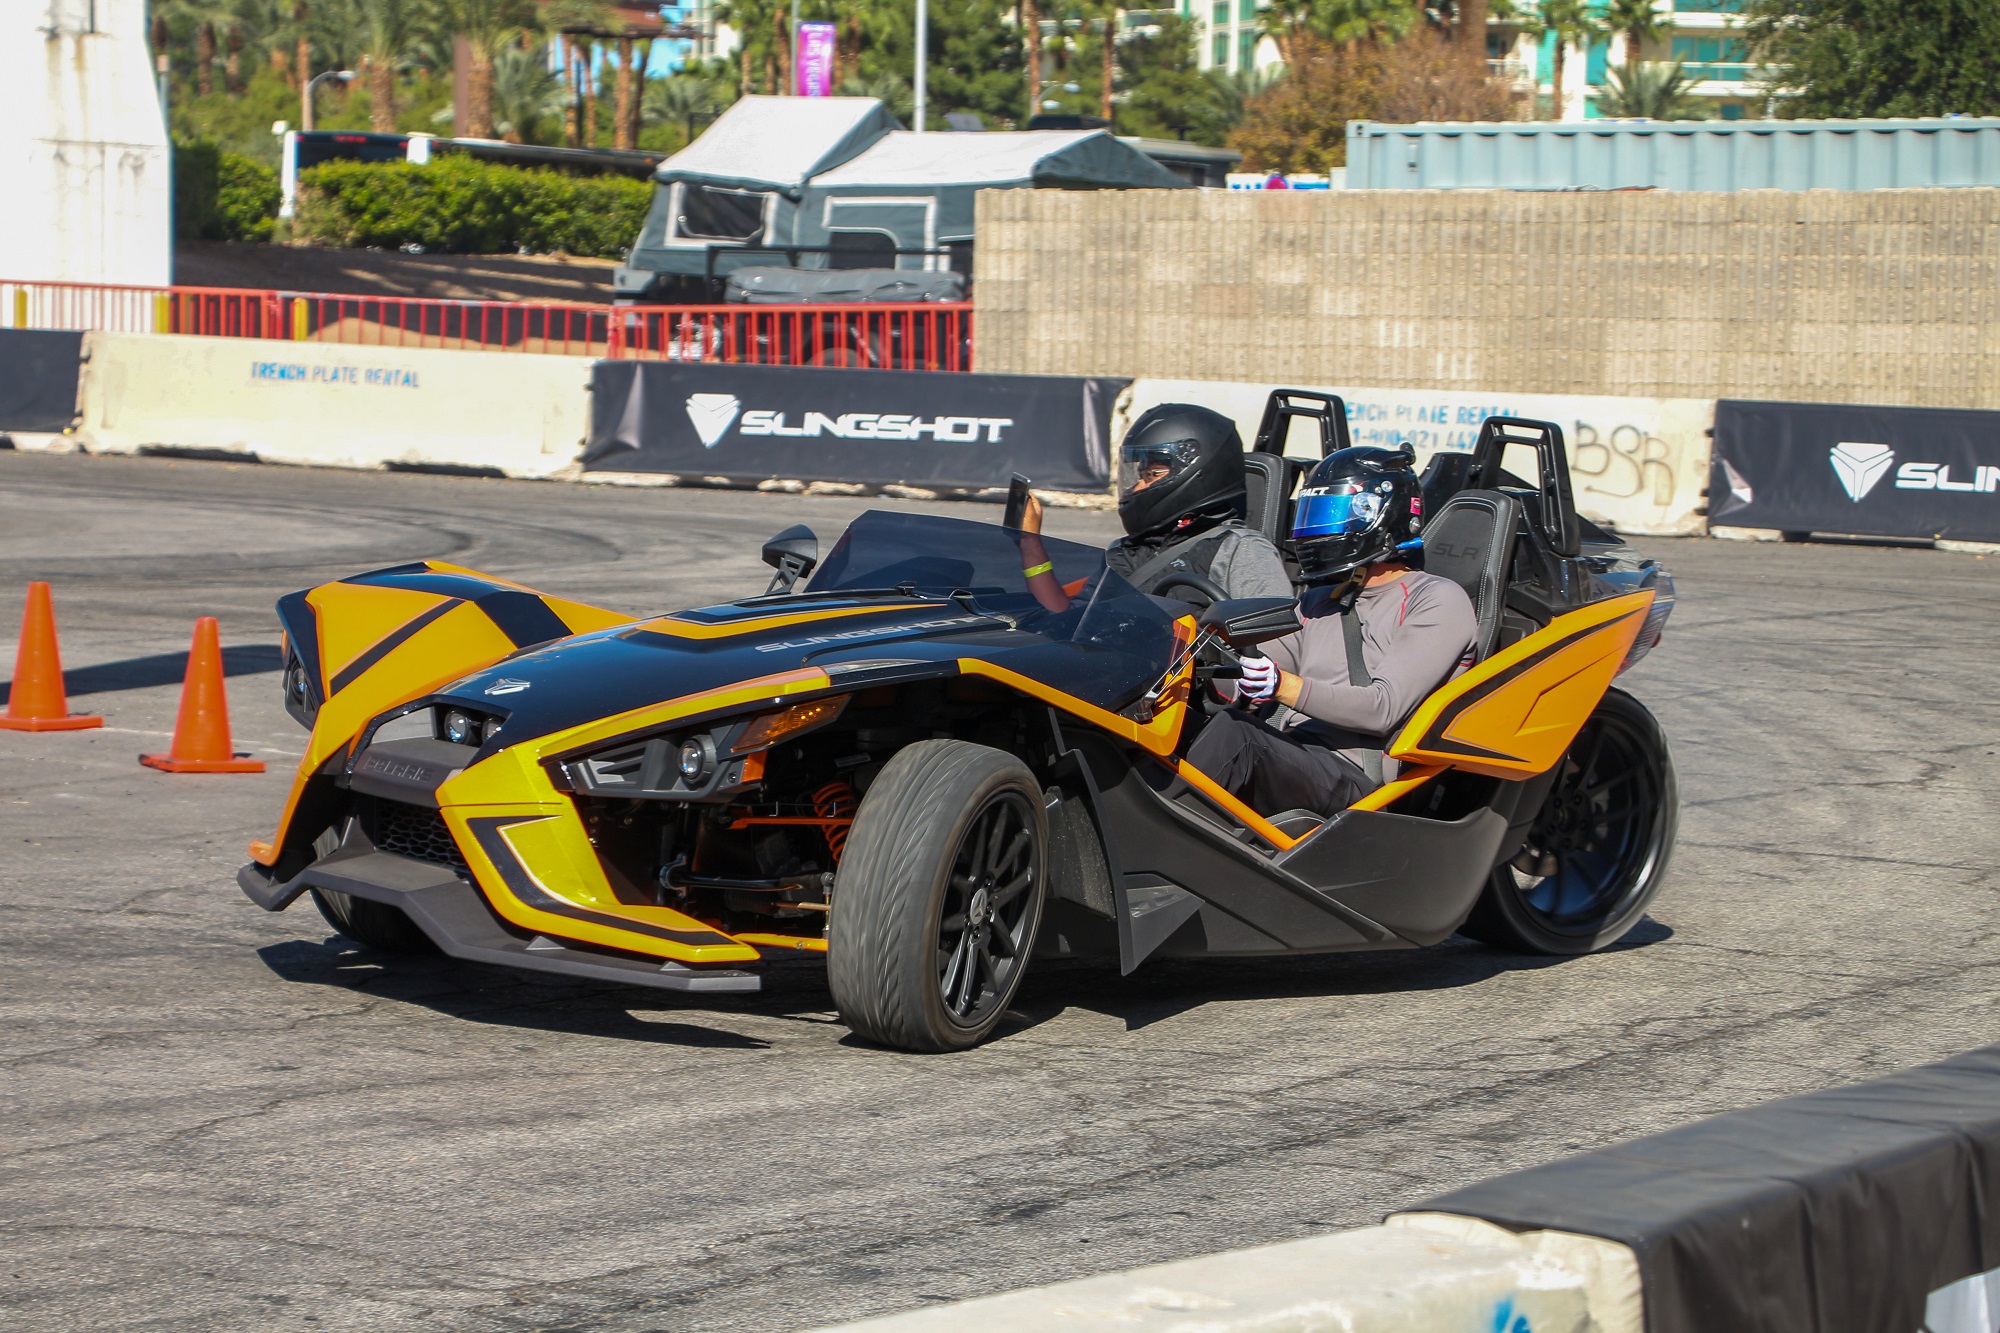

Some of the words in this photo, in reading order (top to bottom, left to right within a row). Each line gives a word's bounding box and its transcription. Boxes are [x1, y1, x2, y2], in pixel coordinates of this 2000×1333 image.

[251, 361, 306, 381] TRENCH
[312, 365, 359, 384] PLATE
[365, 368, 420, 388] RENTAL
[1345, 402, 1388, 421] ENCH
[740, 410, 1014, 443] SLINGSHOT
[1299, 486, 1330, 498] PACT
[1432, 543, 1479, 560] SLR
[754, 616, 988, 653] SLINGSHOT
[363, 756, 433, 783] POLARIS
